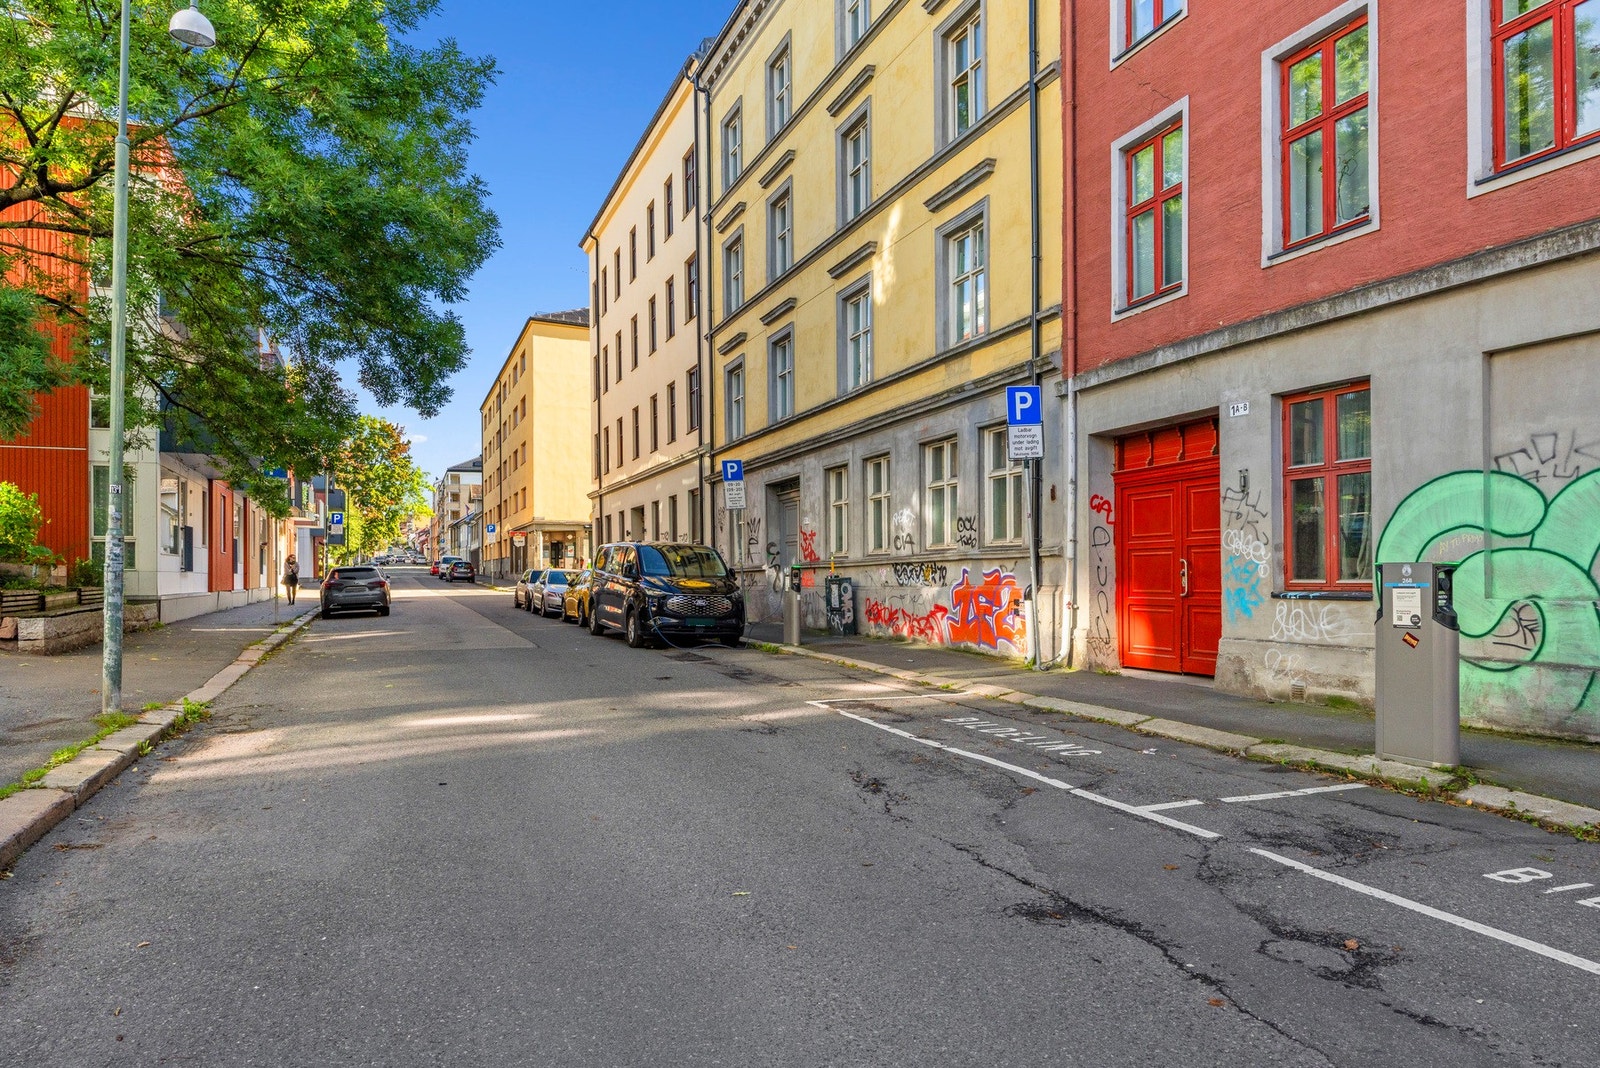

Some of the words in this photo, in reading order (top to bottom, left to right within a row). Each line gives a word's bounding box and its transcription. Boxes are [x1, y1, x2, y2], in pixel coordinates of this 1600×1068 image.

[1015, 391, 1033, 420] P
[727, 462, 738, 479] P
[333, 514, 341, 523] P
